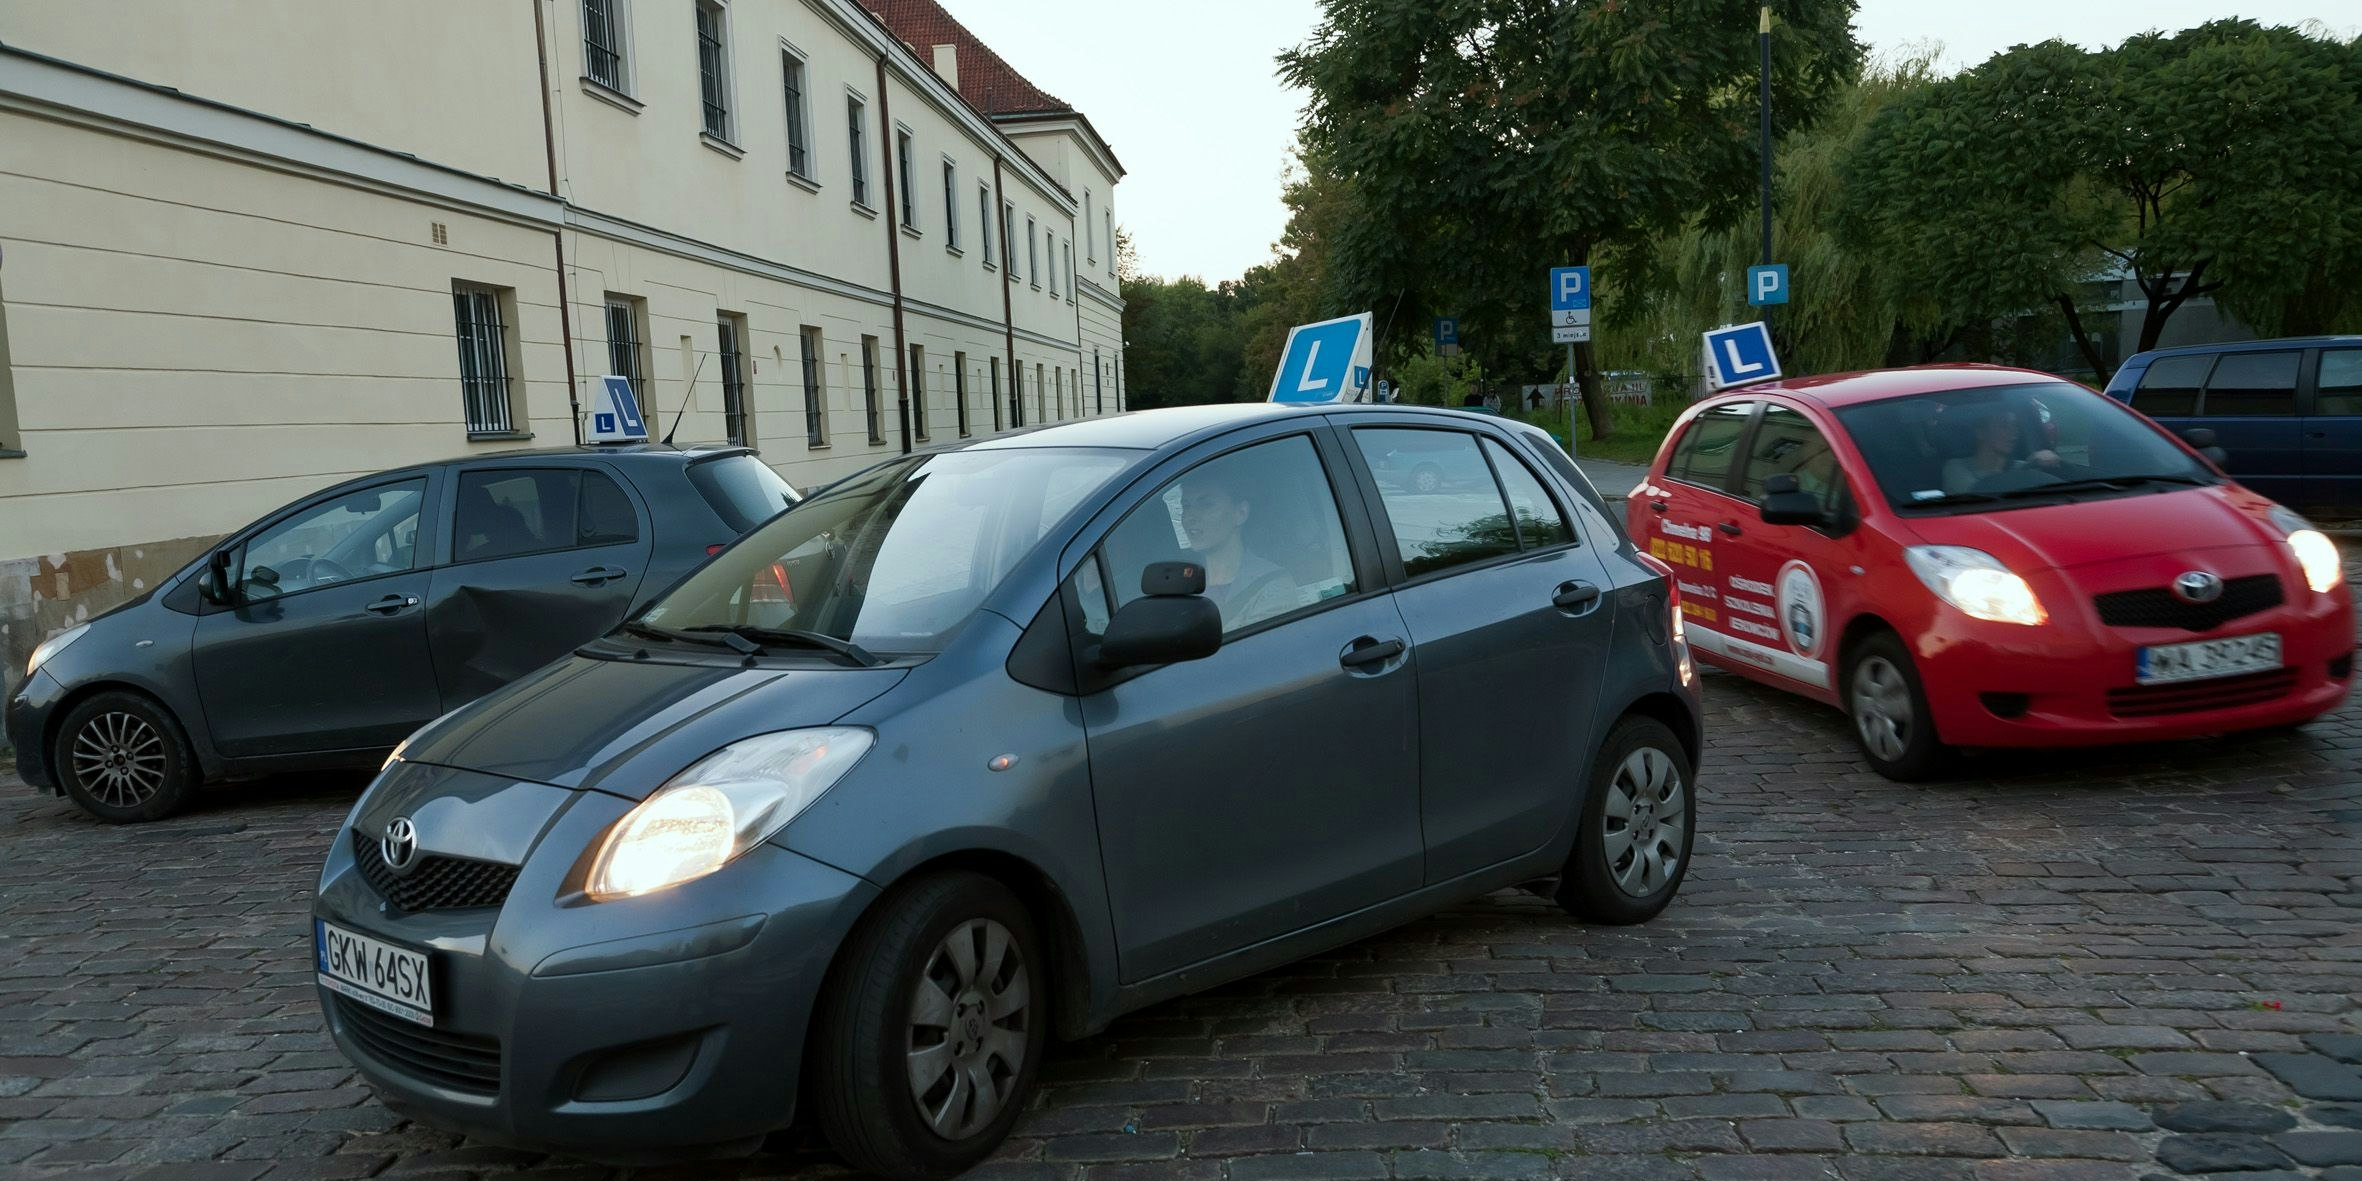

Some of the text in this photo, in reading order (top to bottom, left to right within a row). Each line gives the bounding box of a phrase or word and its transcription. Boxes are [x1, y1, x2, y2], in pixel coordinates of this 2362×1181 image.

[1561, 272, 1581, 302] P
[1758, 271, 1779, 301] P
[1440, 320, 1453, 341] P
[1297, 340, 1328, 391] L
[1724, 339, 1763, 373] L
[1358, 370, 1364, 385] L
[614, 388, 638, 427] L
[601, 416, 611, 430] L
[328, 930, 427, 1005] GKW 64SX
